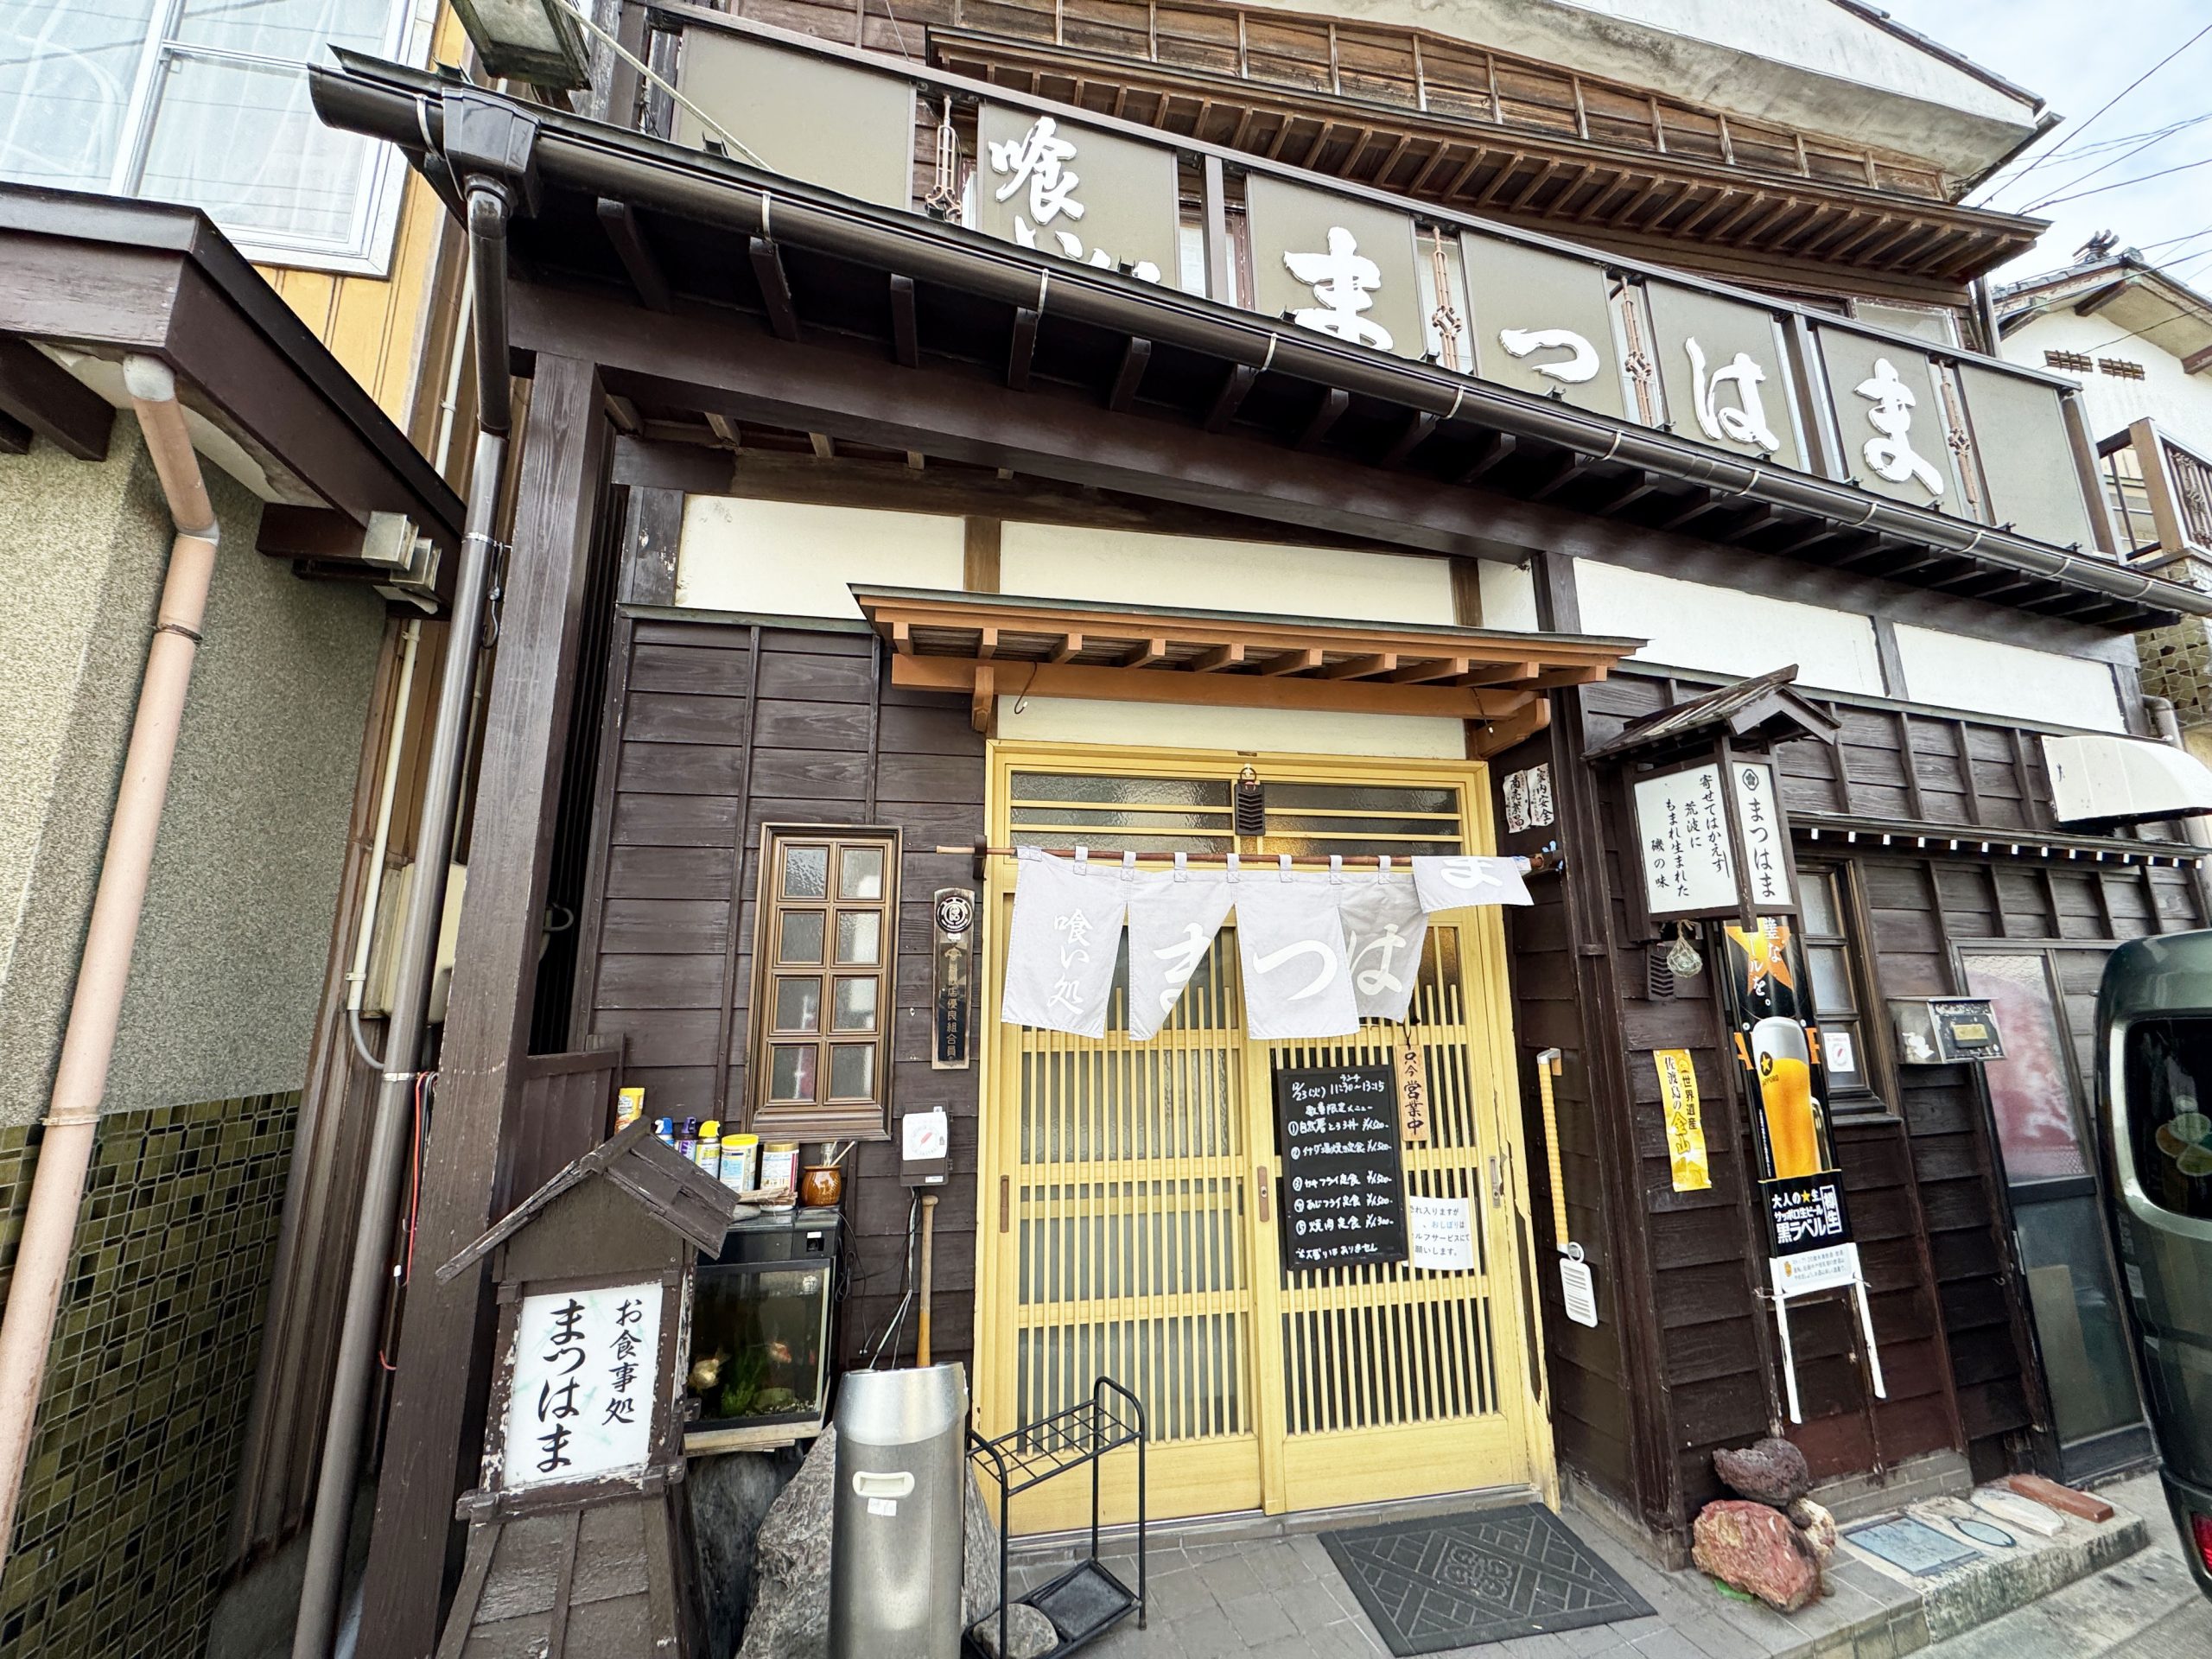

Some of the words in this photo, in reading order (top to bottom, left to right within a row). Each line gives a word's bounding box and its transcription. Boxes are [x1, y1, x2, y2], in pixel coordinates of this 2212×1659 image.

[1650, 838, 1670, 888] 磯の味
[1665, 798, 1689, 898] もまれ生まれた
[1684, 801, 1702, 849] 荒波に
[1699, 773, 1726, 874] 寄せてはかえす
[1748, 797, 1777, 899] まつはま
[1046, 907, 1093, 1015] 喰い処
[1403, 1051, 1425, 1135] 只今営業中
[1664, 1056, 1691, 1155] 佐渡島の金山
[1682, 1075, 1698, 1130] 世界遺産
[1411, 1233, 1471, 1243] ルフサービスにて
[1776, 1217, 1827, 1243] 黒ラベル
[536, 1298, 587, 1473] まつはま
[601, 1298, 643, 1427] お食事処
